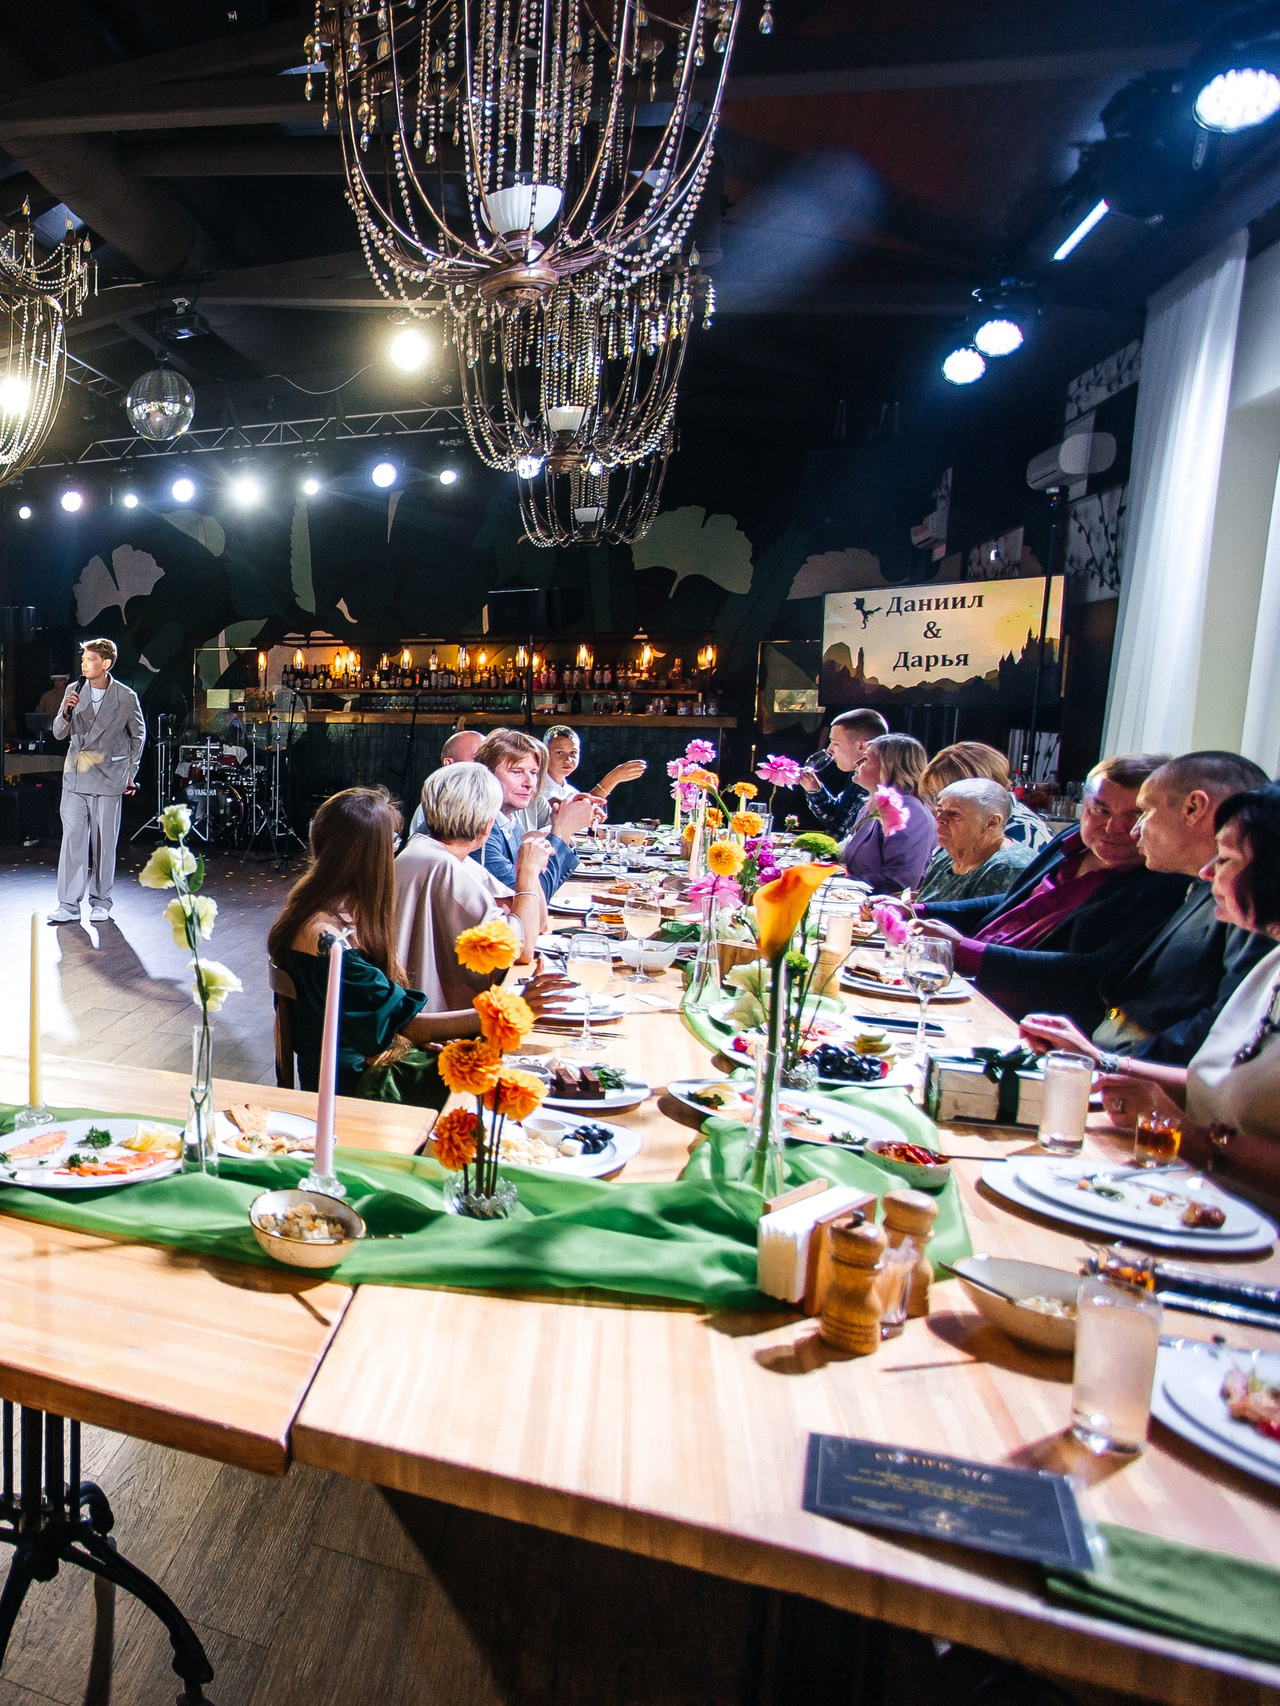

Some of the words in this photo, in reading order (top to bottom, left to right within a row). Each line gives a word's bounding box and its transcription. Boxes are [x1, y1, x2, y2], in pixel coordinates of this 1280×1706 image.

[885, 595, 984, 617] Даниил
[923, 621, 942, 638] &
[893, 652, 969, 671] Дарья
